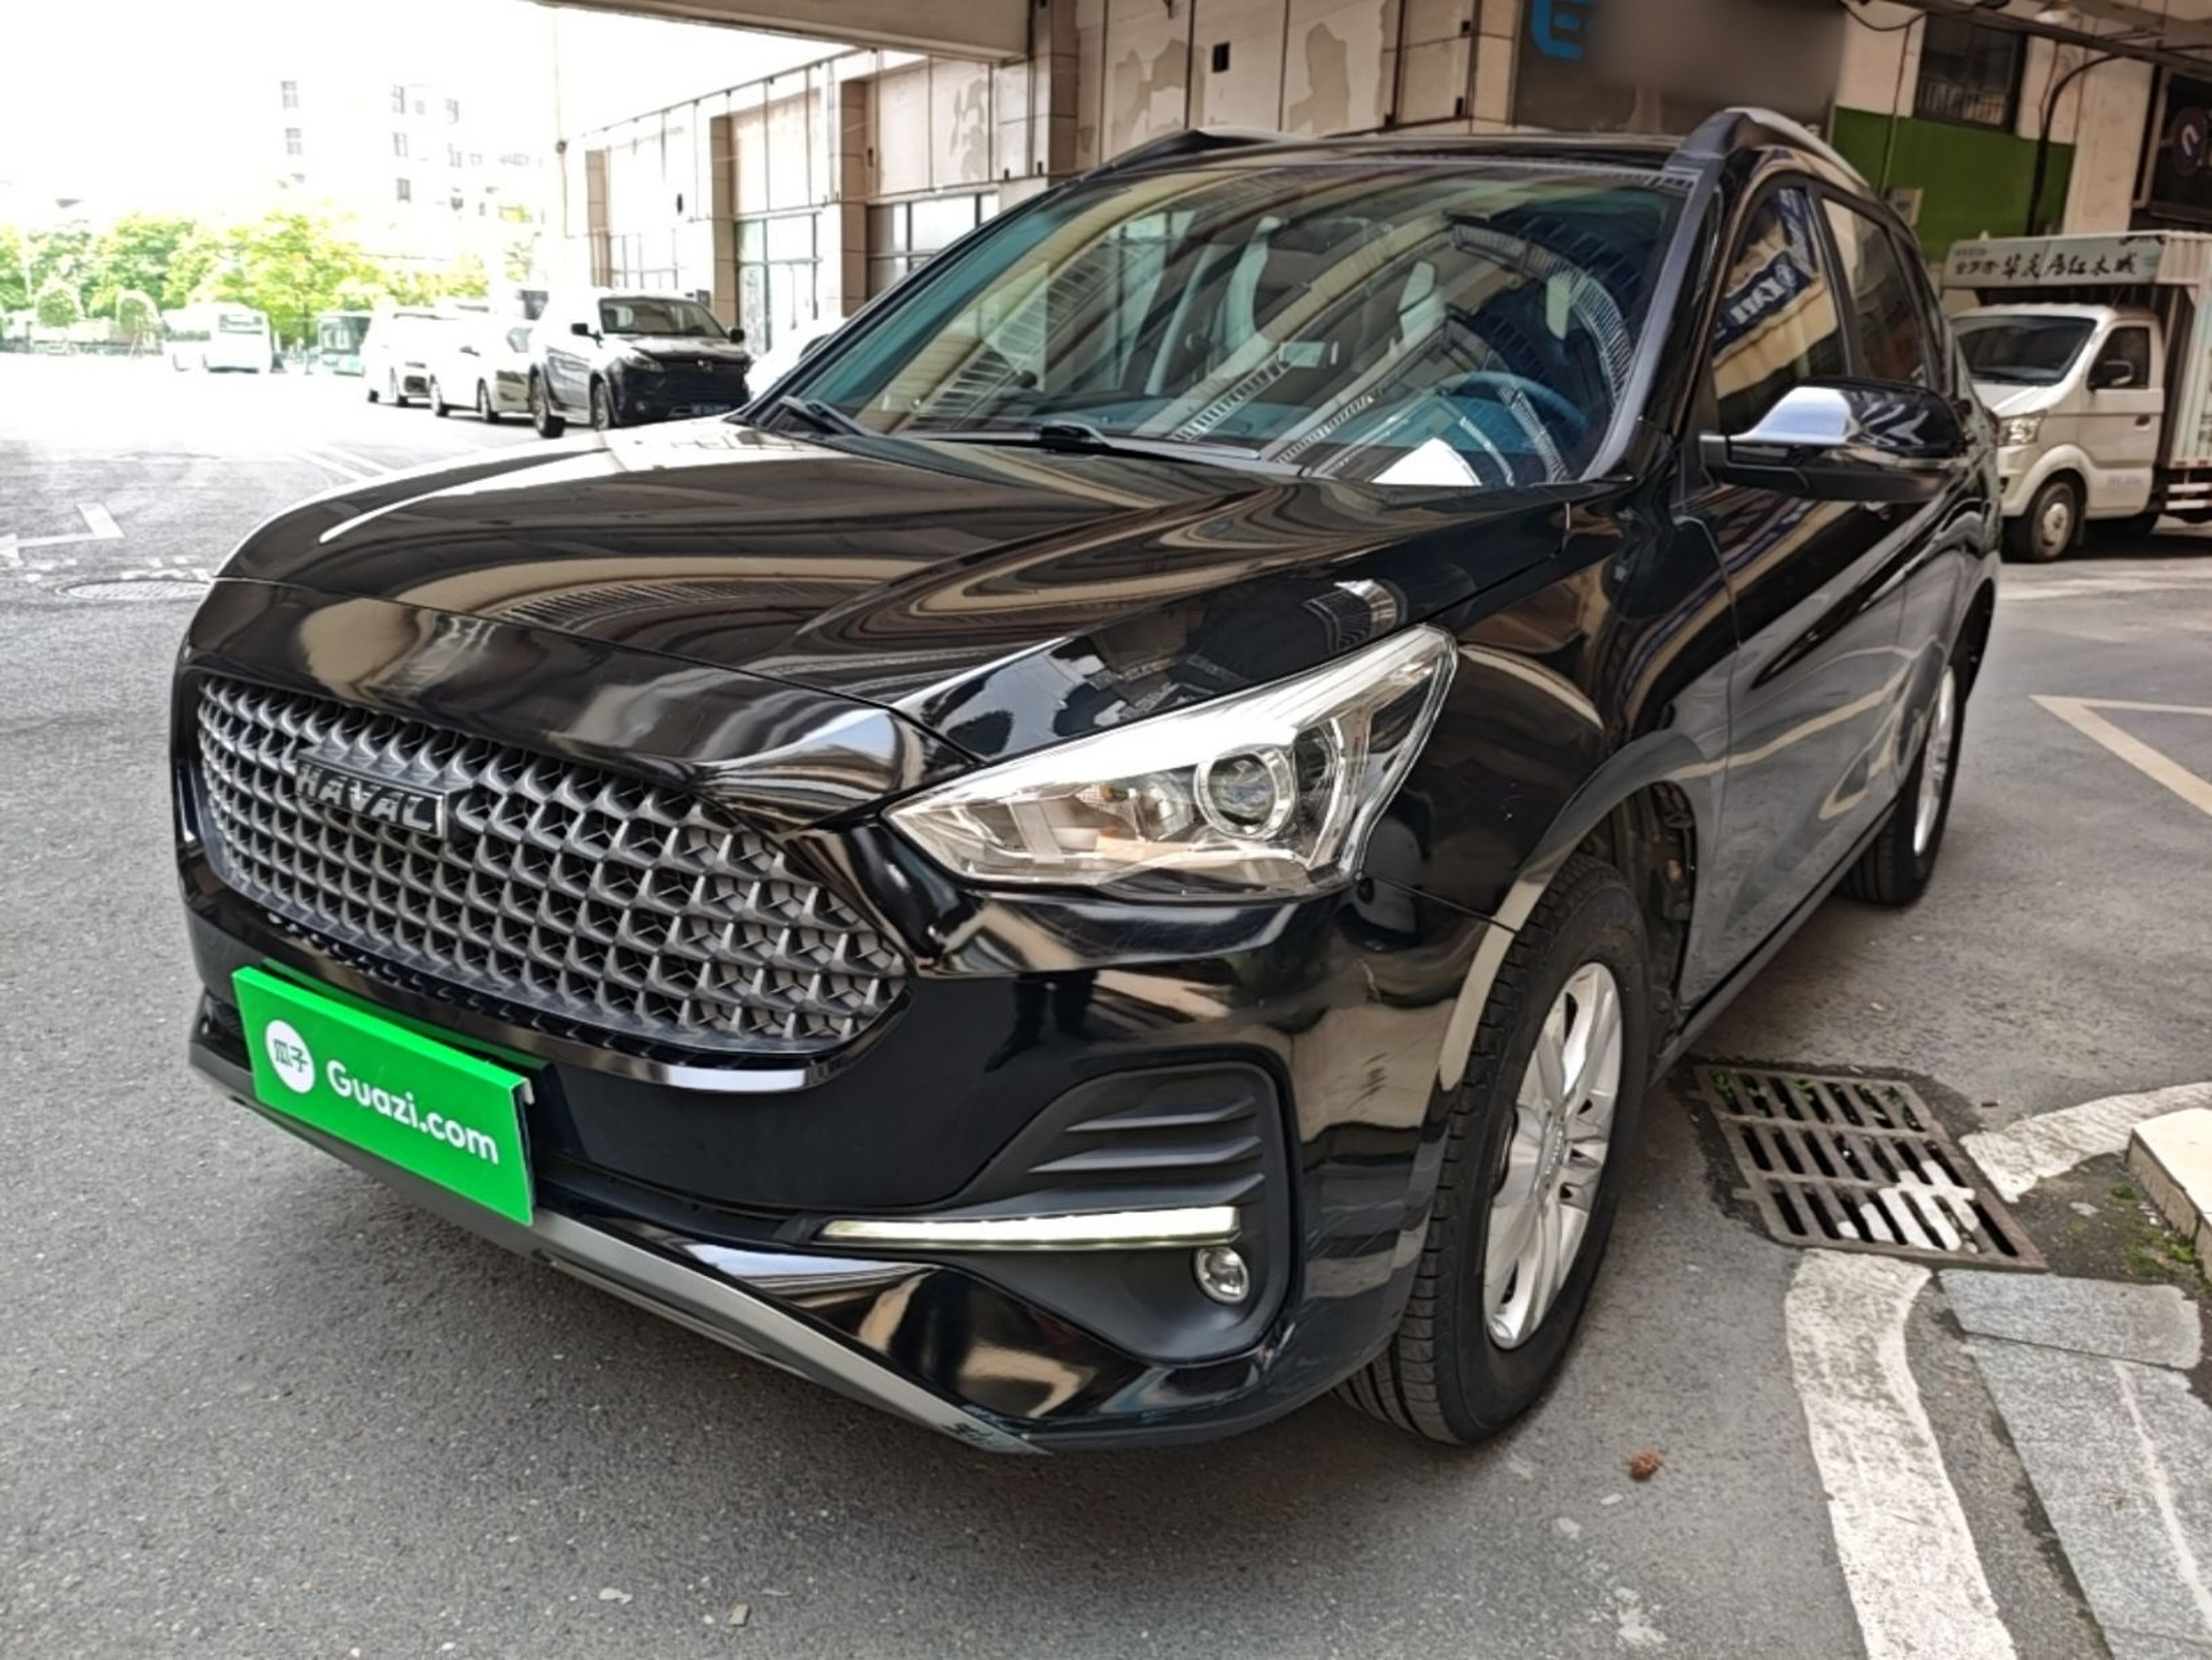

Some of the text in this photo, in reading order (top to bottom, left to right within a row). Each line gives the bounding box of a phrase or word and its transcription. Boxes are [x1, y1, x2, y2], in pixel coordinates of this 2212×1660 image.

[296, 763, 432, 831] HAVAL
[273, 1038, 308, 1073] 瓜子
[326, 1060, 499, 1164] Guazi.com
